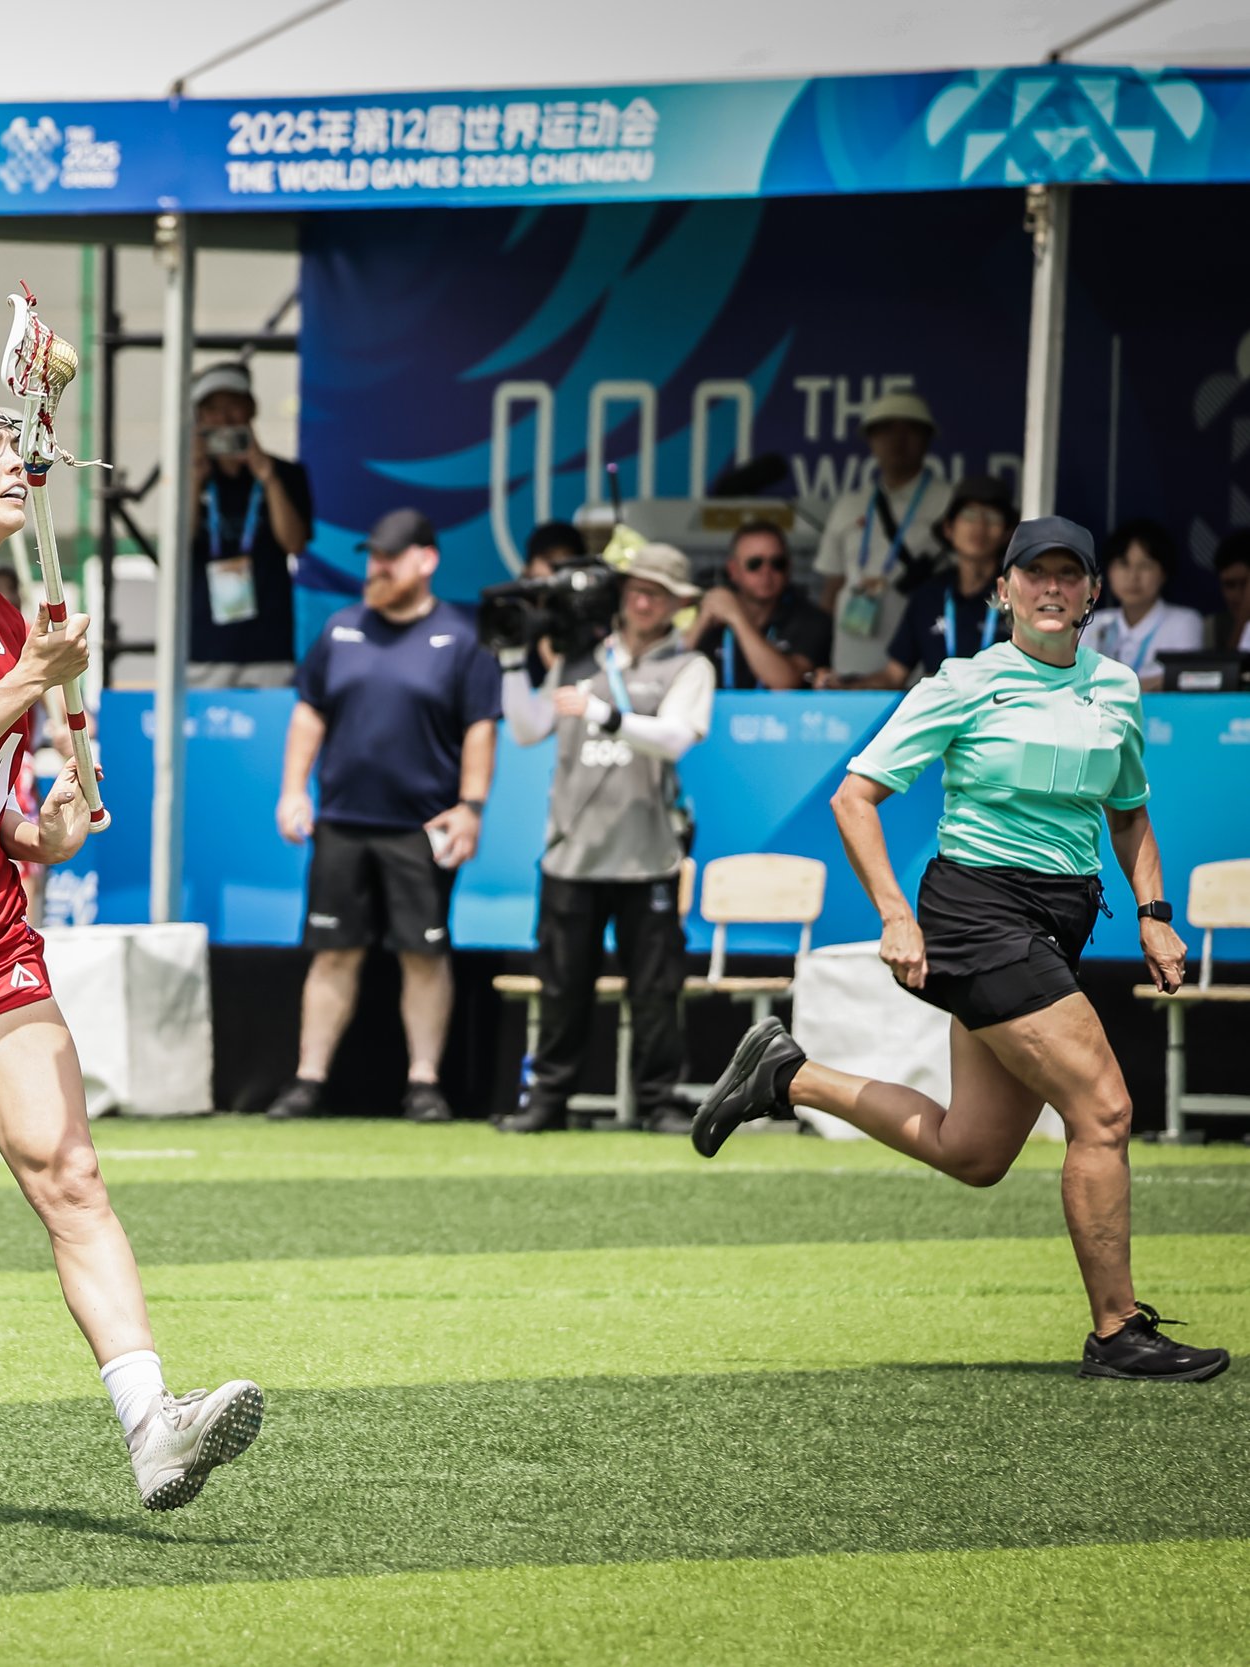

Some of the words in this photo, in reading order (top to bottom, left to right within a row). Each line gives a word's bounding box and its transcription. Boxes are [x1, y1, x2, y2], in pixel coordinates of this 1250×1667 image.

[226, 97, 659, 157] 2025年第12届世界运动会
[225, 161, 276, 194] THE
[278, 158, 370, 193] WORLD
[371, 155, 460, 191] GAMES
[462, 153, 529, 188] 2025
[531, 150, 655, 187] CHENGDU
